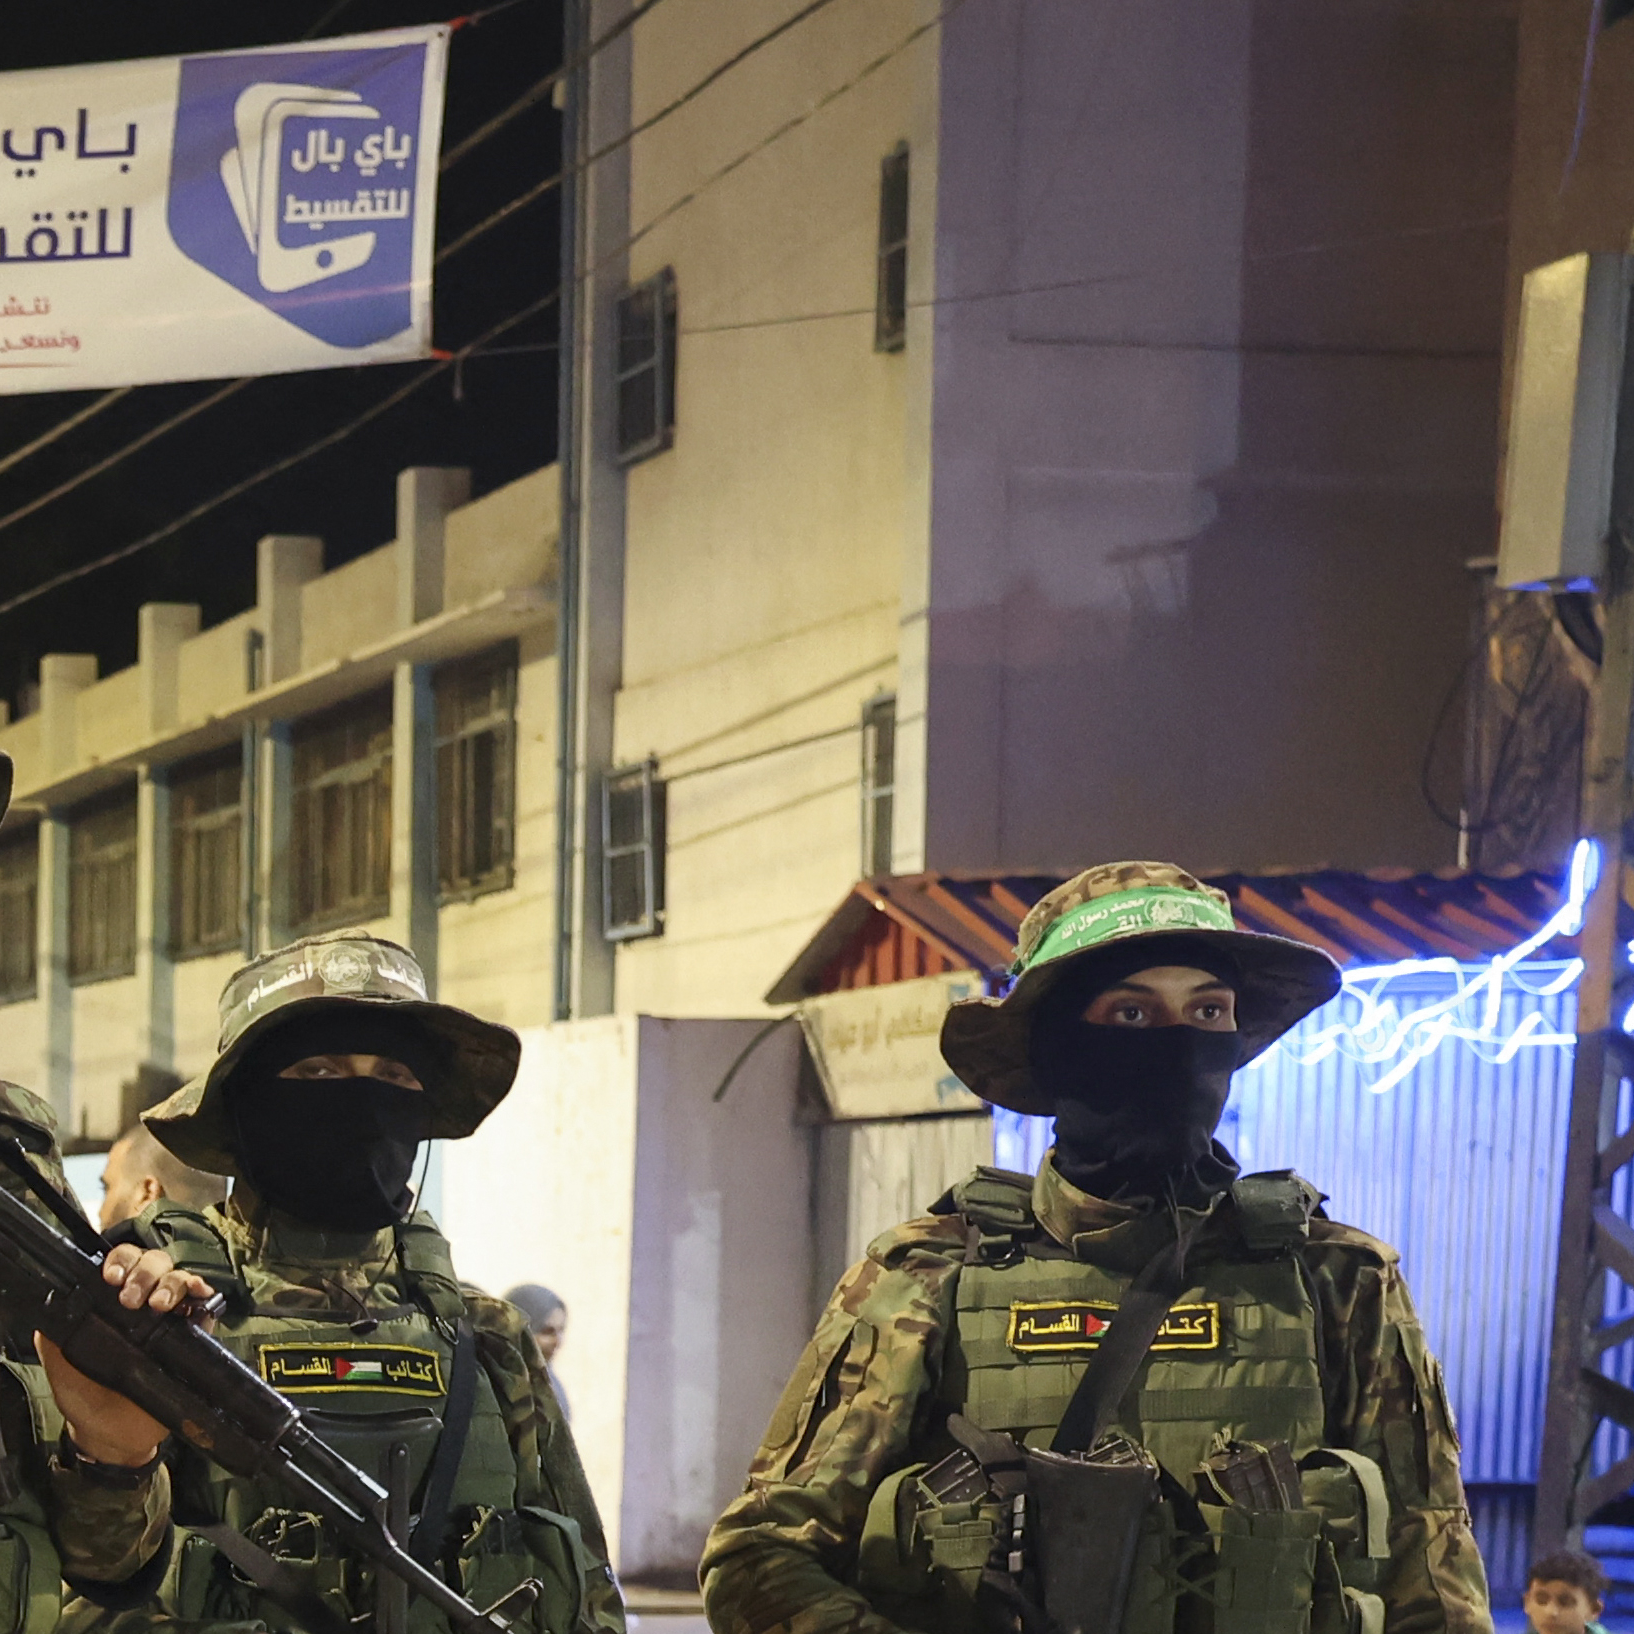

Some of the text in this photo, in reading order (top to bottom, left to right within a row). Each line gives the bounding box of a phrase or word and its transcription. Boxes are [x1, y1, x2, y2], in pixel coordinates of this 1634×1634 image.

[1, 108, 137, 179] باي
[291, 125, 412, 177] باي بال
[284, 188, 411, 231] للتقسيط
[247, 960, 313, 1011] القسام
[1019, 1313, 1080, 1339] القسام
[271, 1357, 433, 1382] كتائب القسام
